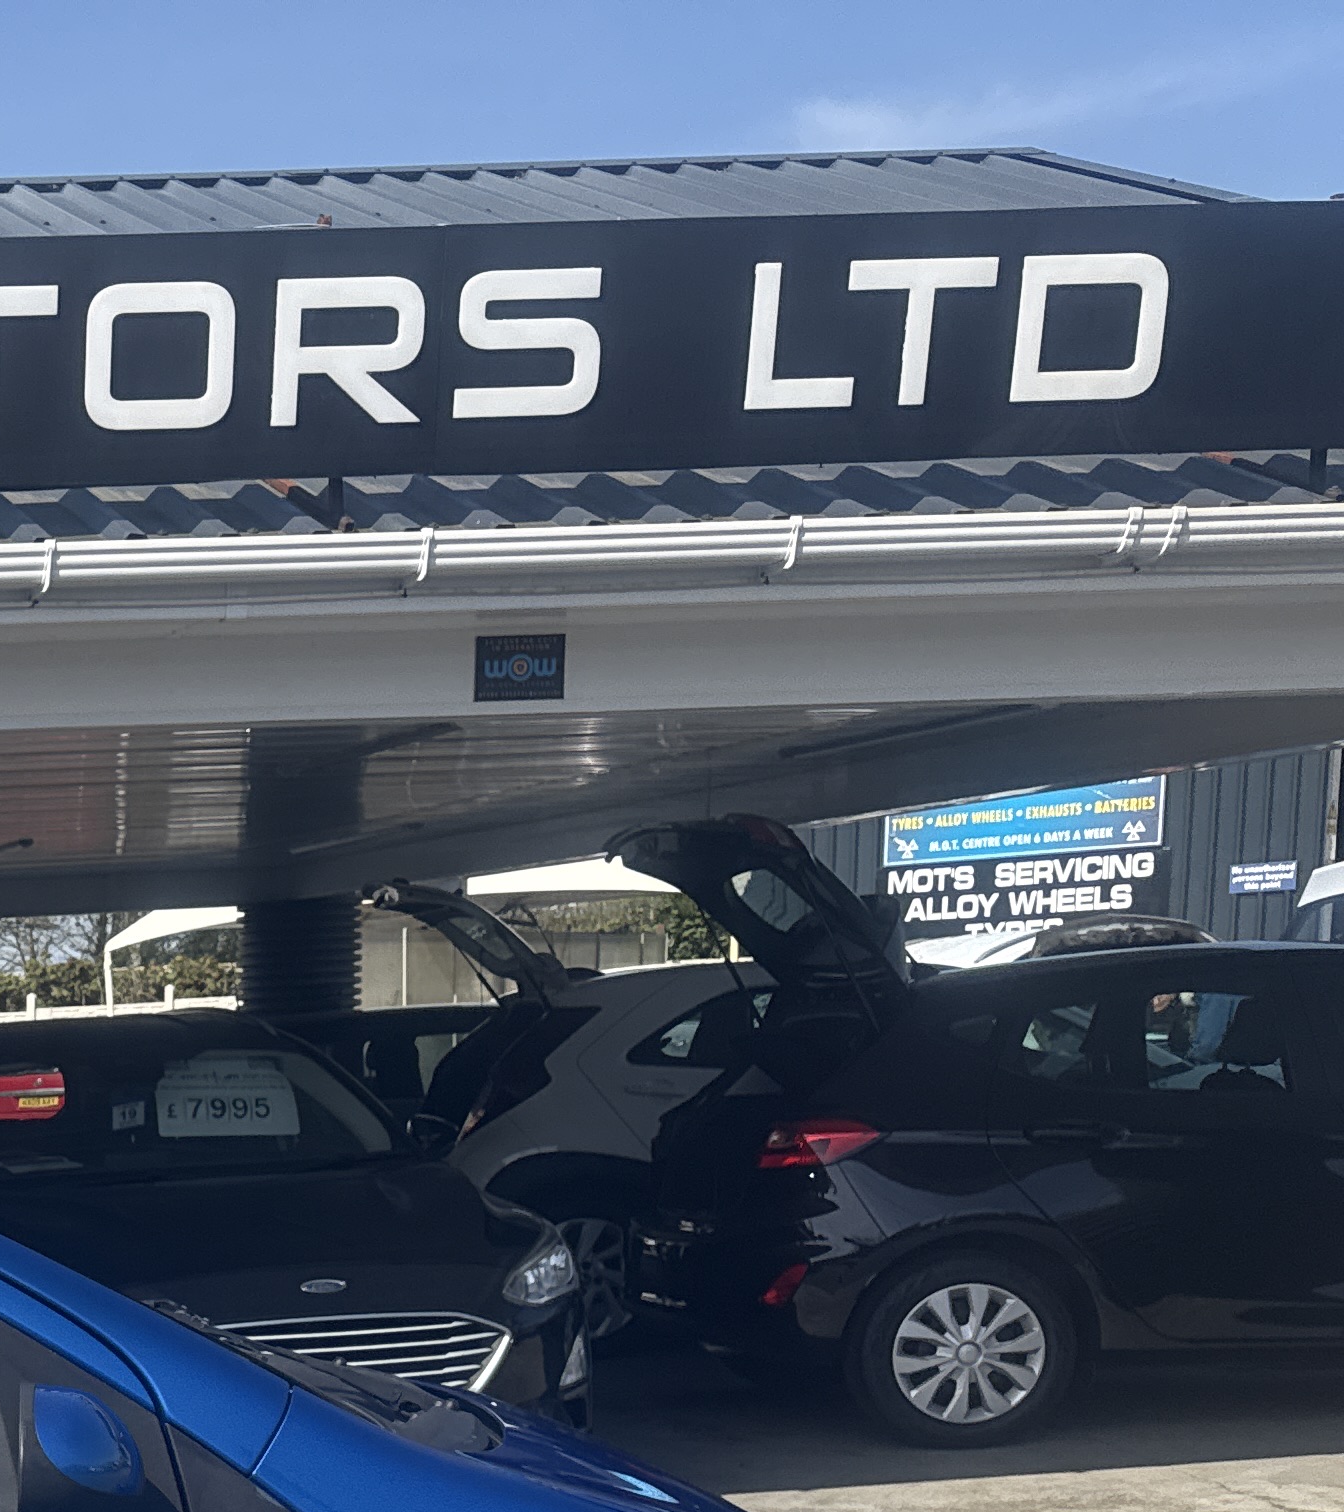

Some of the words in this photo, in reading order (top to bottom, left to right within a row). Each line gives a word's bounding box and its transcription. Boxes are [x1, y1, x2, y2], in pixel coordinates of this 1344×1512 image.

[742, 252, 1170, 411] LTD
[892, 815, 924, 831] TYRES
[934, 812, 969, 827] ALLOY
[972, 808, 1014, 824] WHEELS
[1025, 802, 1082, 820] EXHAUSTS
[1094, 796, 1156, 814] BATTERIES
[962, 835, 1001, 849] CENTRE
[1003, 833, 1032, 847] OPEN
[1033, 832, 1042, 844] 6
[1043, 829, 1071, 843] DAYS
[1072, 829, 1082, 840] A
[1084, 827, 1114, 840] WEEK
[887, 865, 975, 894] MOT'S
[994, 852, 1155, 888] SERVICING
[904, 893, 999, 922] ALLOY
[1008, 883, 1133, 919] WHEELS
